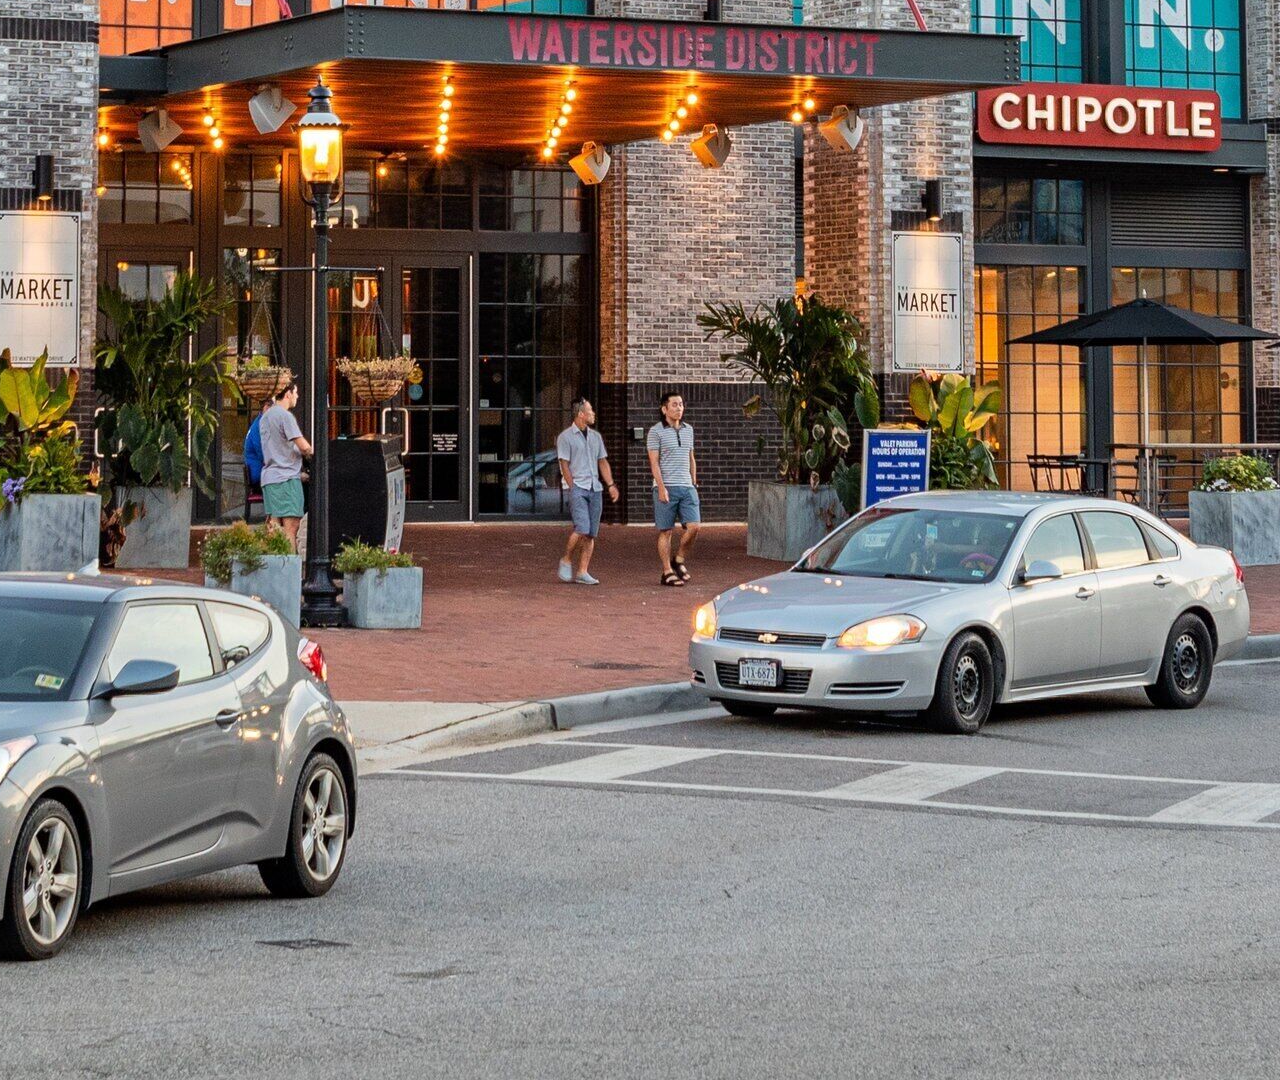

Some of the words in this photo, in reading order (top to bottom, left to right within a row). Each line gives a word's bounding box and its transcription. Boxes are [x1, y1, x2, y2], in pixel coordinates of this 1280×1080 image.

[507, 19, 718, 70] WATERSIDE
[725, 27, 881, 76] DISTRICT
[992, 92, 1216, 138] CHIPOTLE
[0, 278, 73, 300] MARKET
[897, 292, 957, 313] MARKET
[872, 447, 890, 456] HOURS
[891, 447, 898, 455] OF
[898, 447, 926, 456] OPERATION
[880, 440, 895, 448] VALET
[896, 440, 918, 448] PARKING
